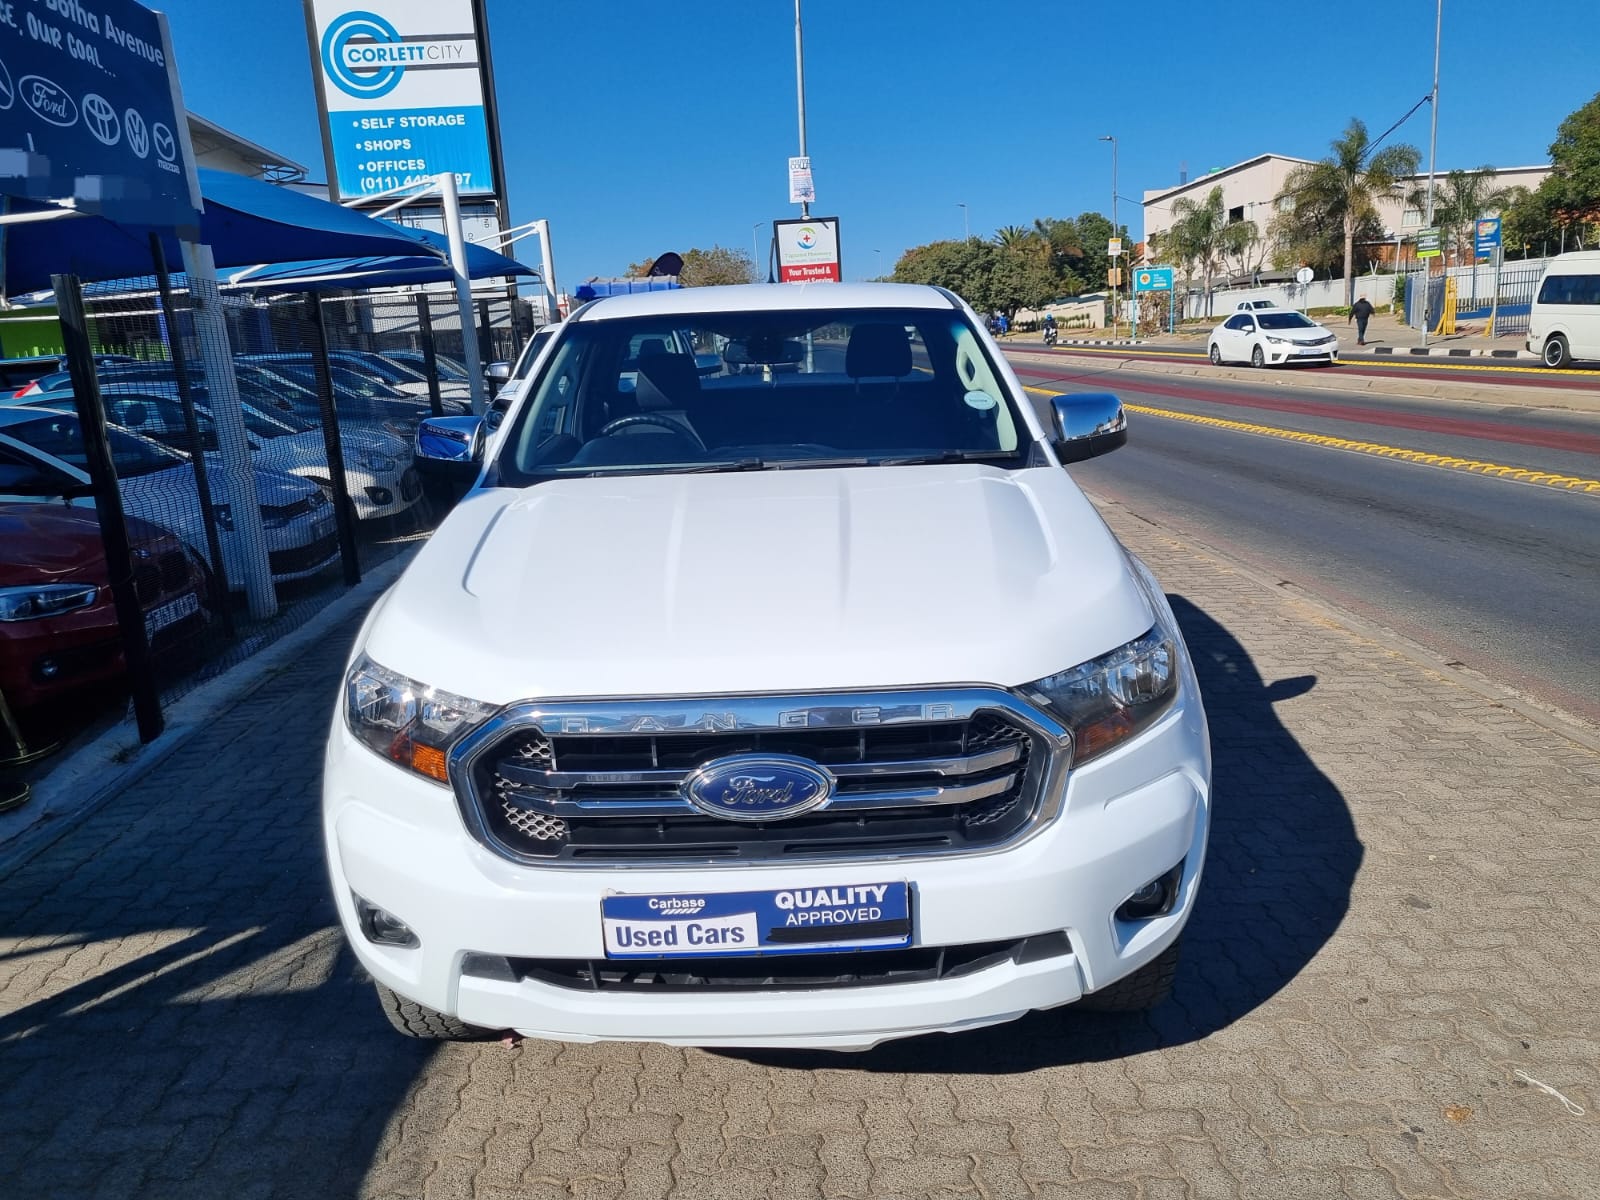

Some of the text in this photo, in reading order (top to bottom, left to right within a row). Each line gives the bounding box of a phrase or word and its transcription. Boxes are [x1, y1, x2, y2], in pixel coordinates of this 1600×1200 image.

[27, 11, 63, 50] OUR
[105, 14, 165, 67] Avenue
[31, 82, 68, 119] Ford
[361, 114, 466, 129] SELF STORAGE
[363, 138, 412, 152] SHOPS
[366, 159, 426, 172] OFFICES
[360, 175, 399, 193] (011)
[803, 266, 825, 275] Trusted
[561, 703, 957, 734] RANGER
[721, 774, 793, 806] Ford
[648, 897, 706, 911] Carbase
[774, 884, 888, 910] QUALITY
[785, 907, 881, 926] APPROVED
[616, 922, 745, 948] Used Cars
